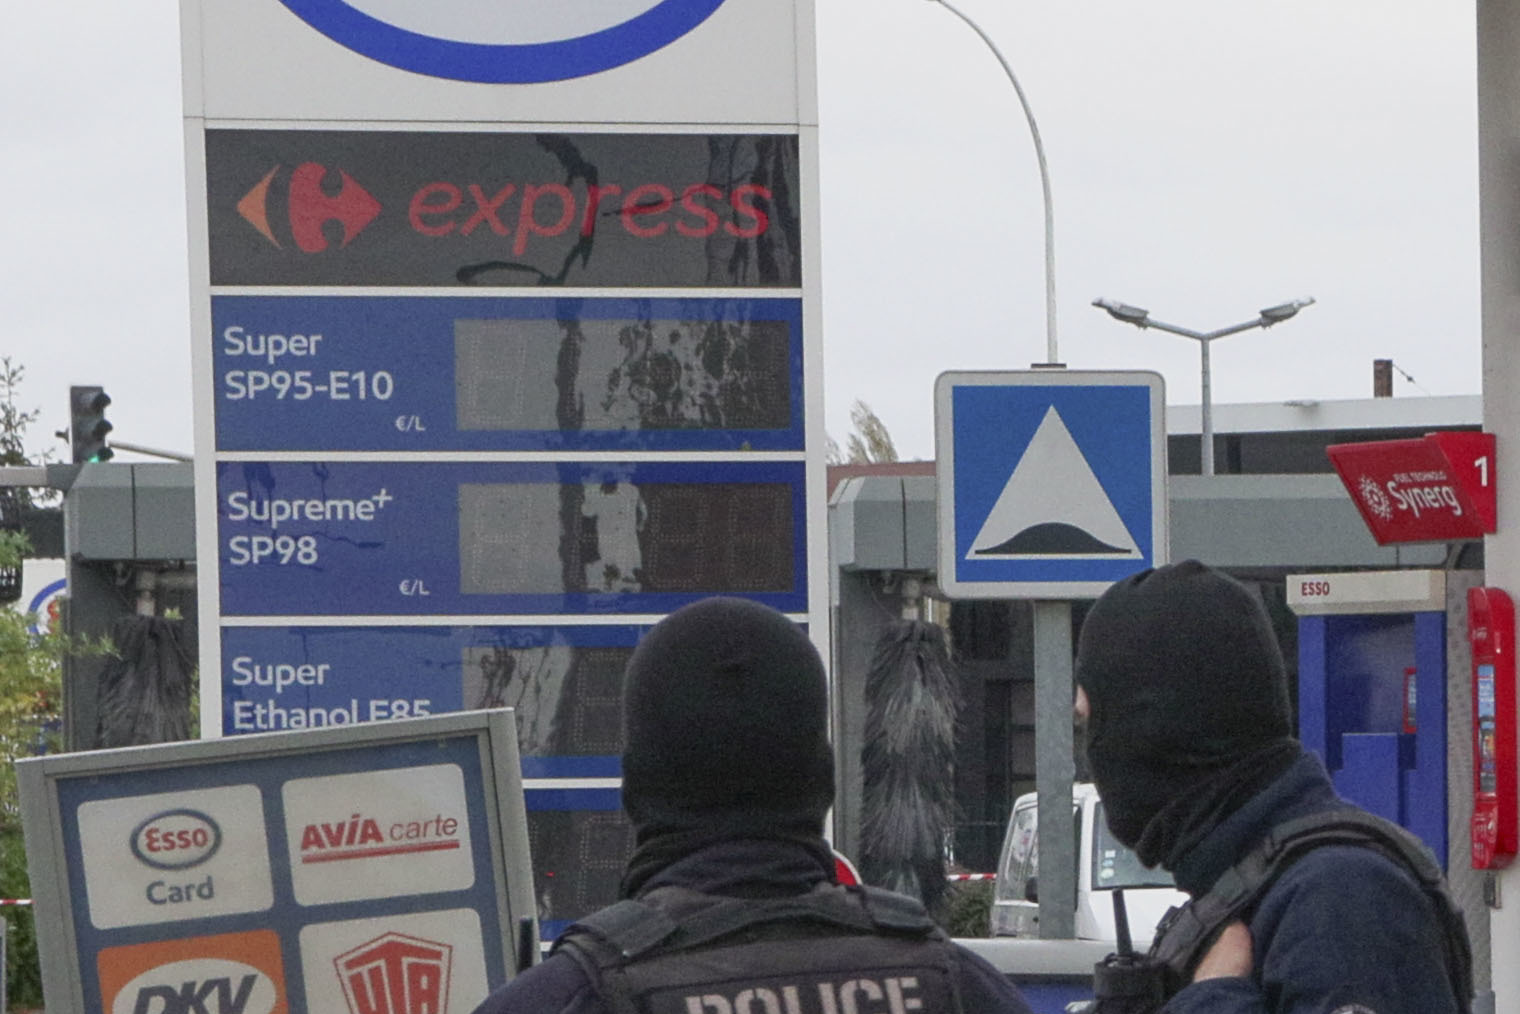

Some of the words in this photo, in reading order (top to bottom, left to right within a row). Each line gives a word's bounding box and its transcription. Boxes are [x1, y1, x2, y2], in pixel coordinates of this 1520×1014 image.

[408, 181, 772, 255] express
[223, 327, 322, 363] Super
[225, 371, 393, 401] SP95-E10
[395, 415, 425, 431] €/L
[1474, 456, 1487, 486] 1
[1387, 481, 1463, 517] Synerg
[229, 536, 318, 565] SP98
[400, 580, 429, 596] €/L
[1301, 582, 1330, 596] ESSO
[232, 657, 330, 692] Super
[233, 699, 358, 729] Ethanol
[144, 822, 208, 853] Esso
[389, 814, 458, 841] carte
[145, 876, 214, 905] Card
